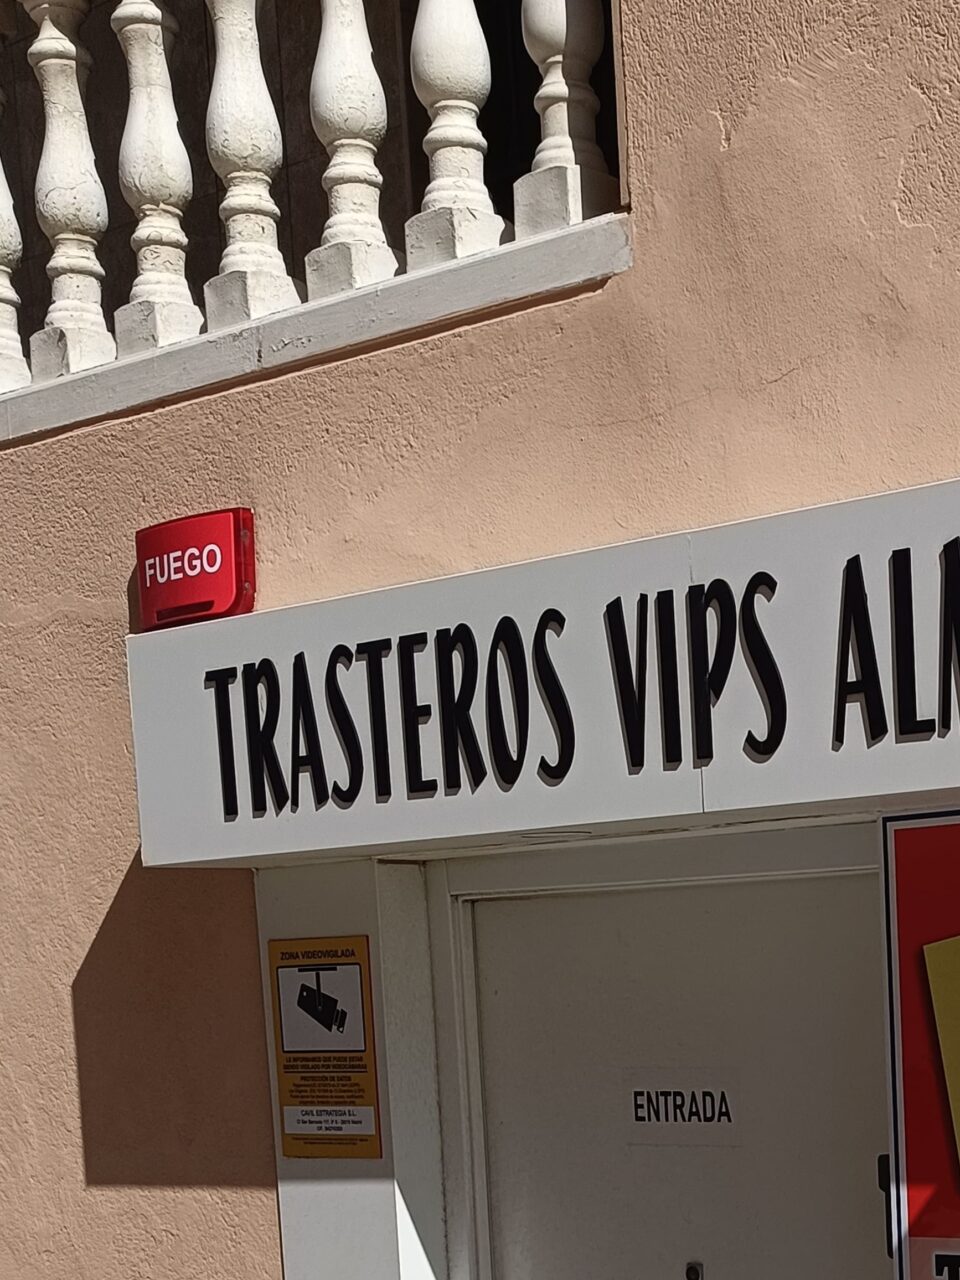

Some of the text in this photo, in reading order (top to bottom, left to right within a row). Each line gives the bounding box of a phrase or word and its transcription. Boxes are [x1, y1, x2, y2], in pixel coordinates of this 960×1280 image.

[144, 542, 222, 588] FUEGO
[204, 608, 576, 823] TRASTEROS
[603, 571, 788, 776] VIPS
[633, 1090, 732, 1123] ENTRADA
